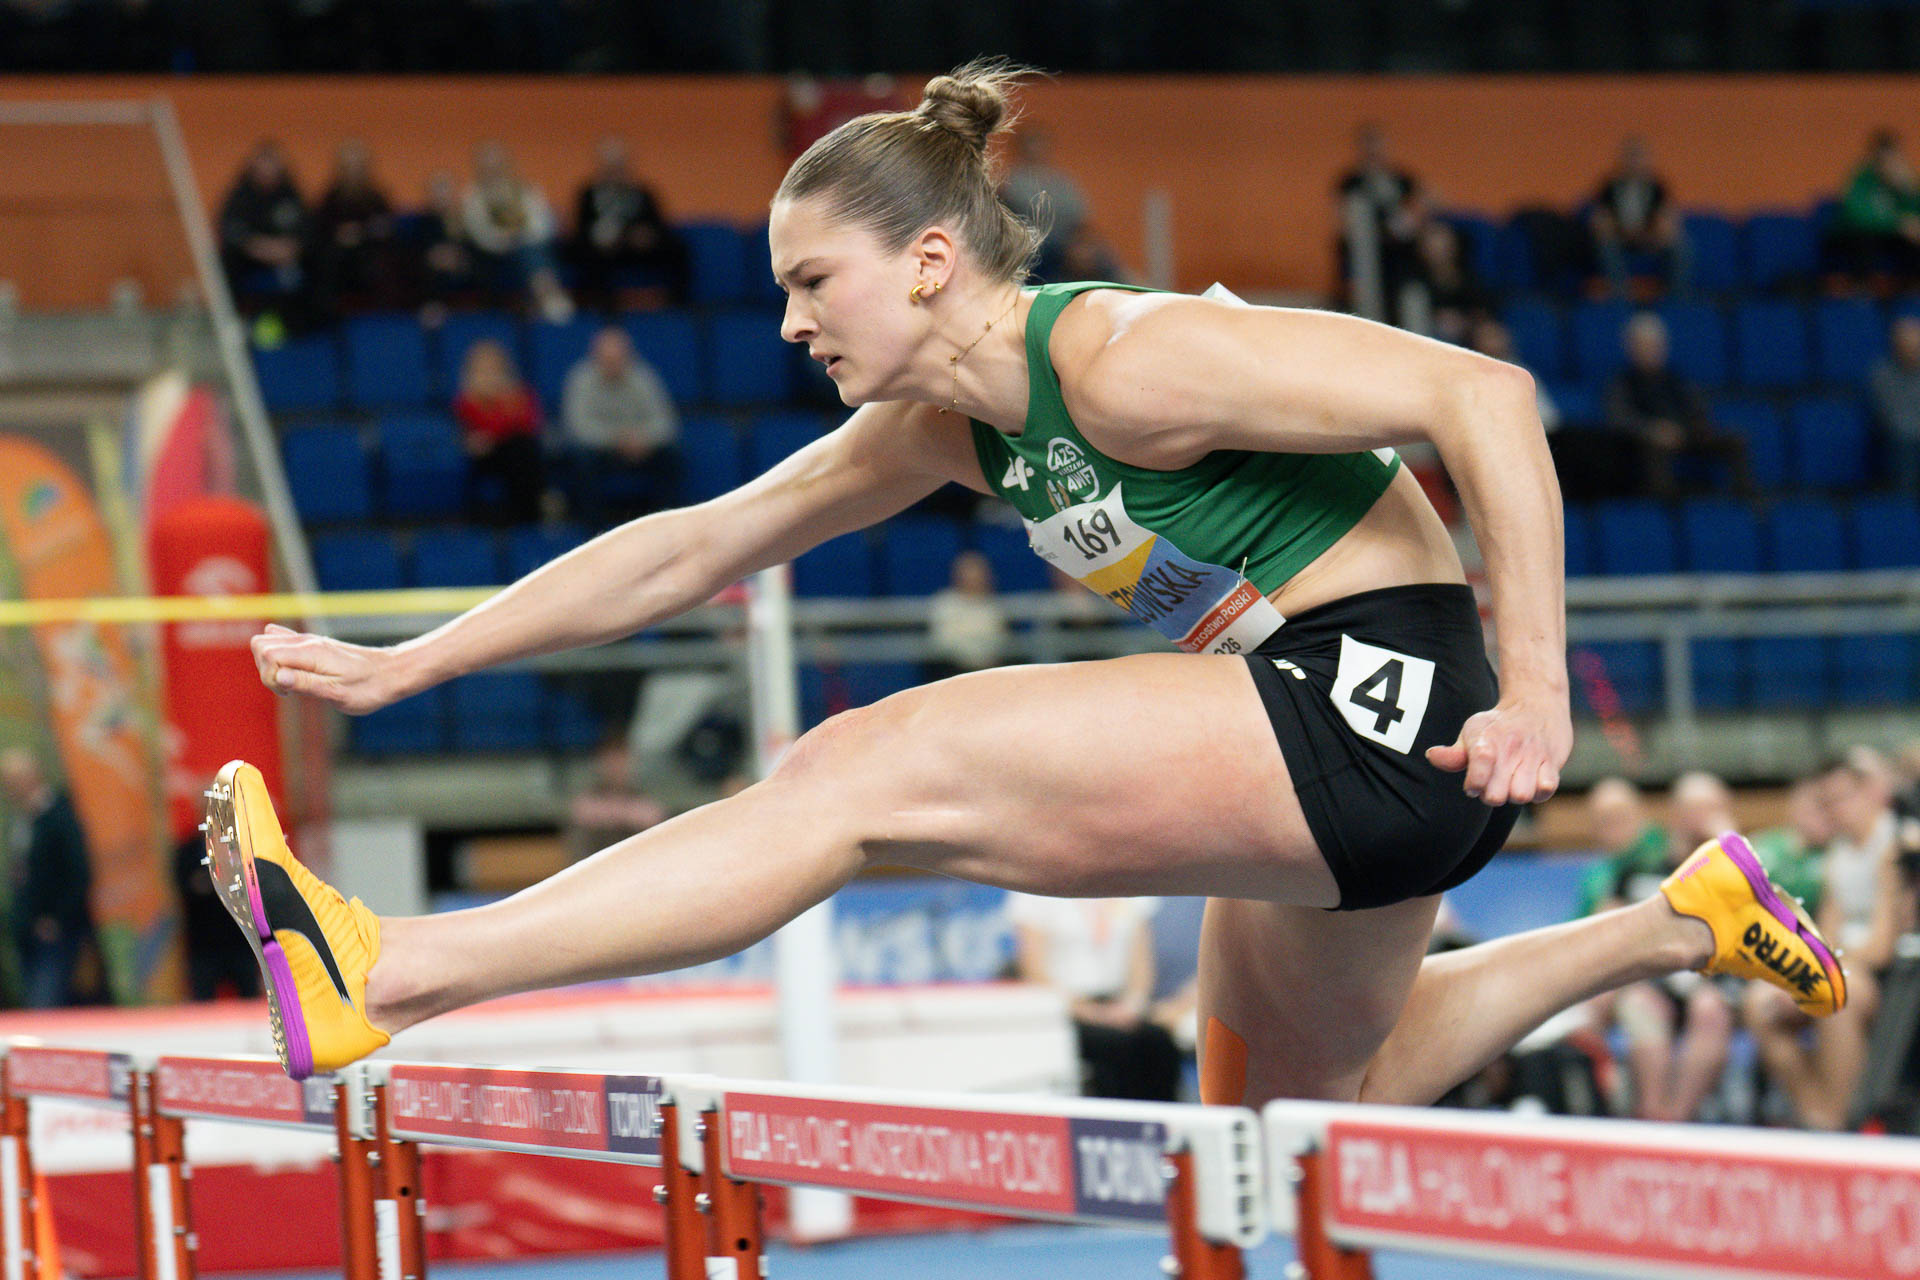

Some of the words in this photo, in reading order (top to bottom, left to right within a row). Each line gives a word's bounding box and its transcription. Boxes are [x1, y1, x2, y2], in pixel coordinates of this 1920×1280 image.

[1054, 445, 1077, 468] AZS
[1067, 470, 1092, 494] AWF
[1063, 508, 1122, 560] 169
[1220, 588, 1252, 620] Polski
[1350, 658, 1405, 736] 4
[1743, 922, 1823, 997] NITRO
